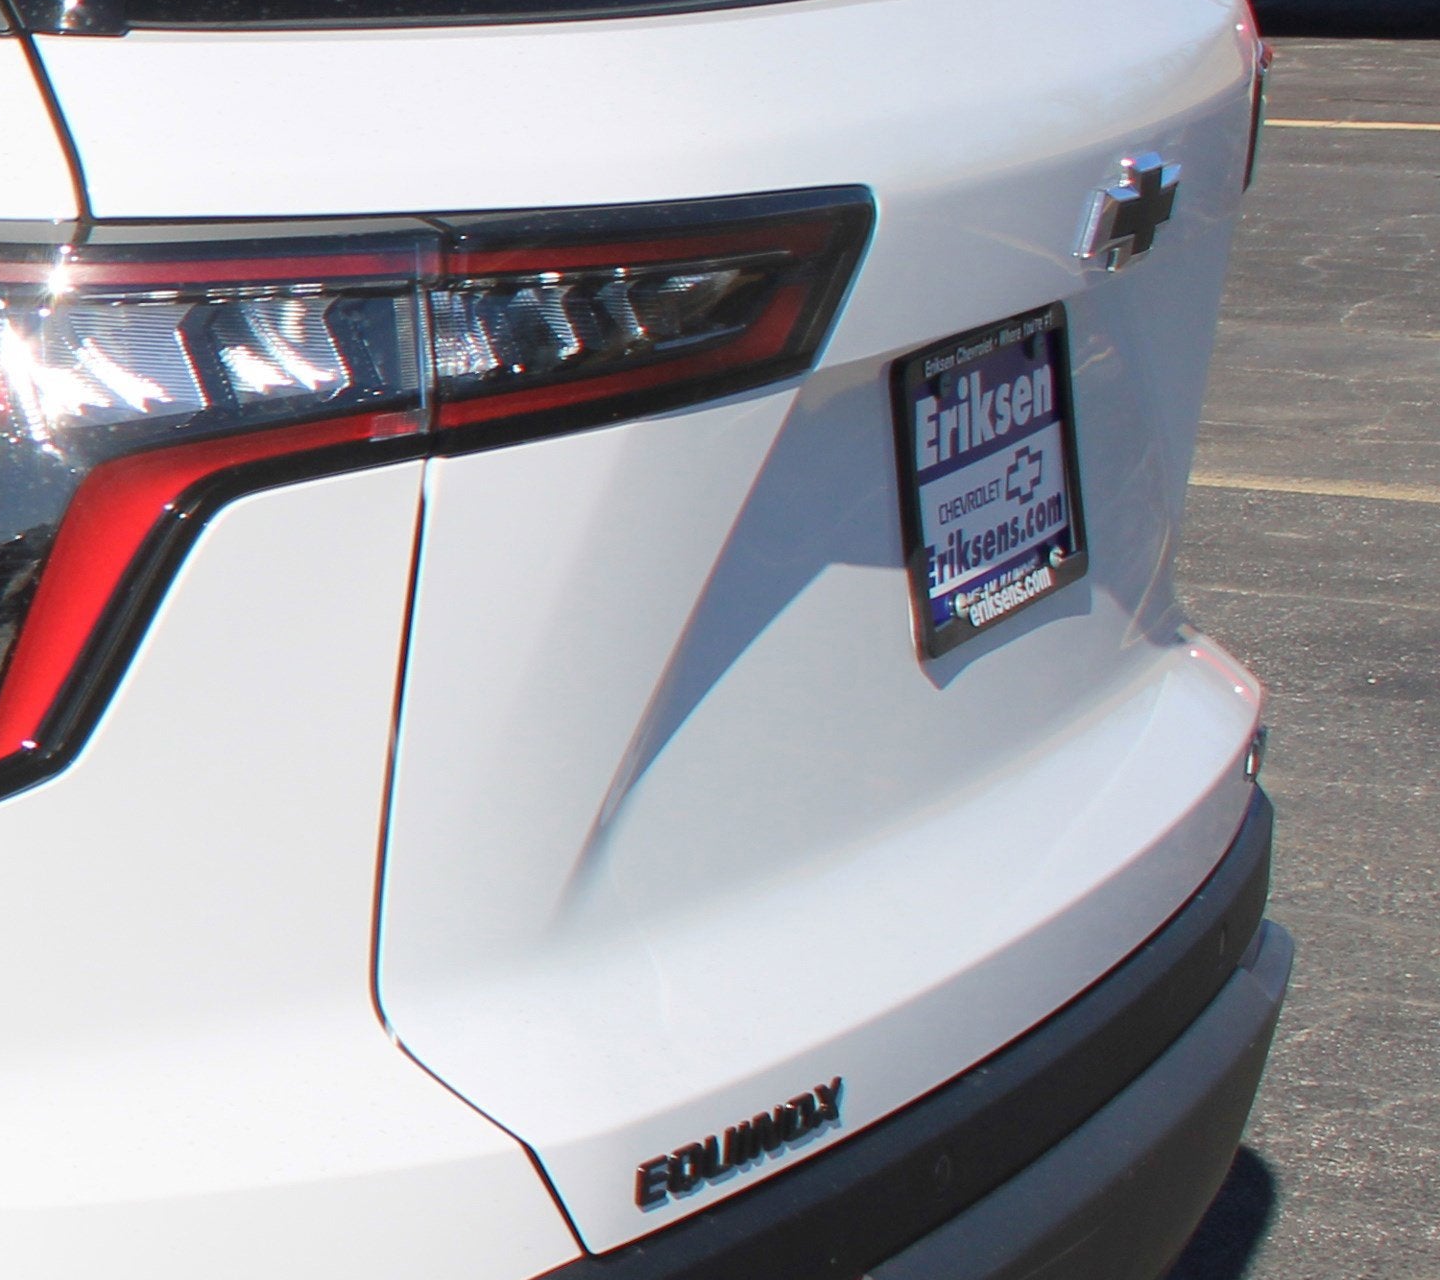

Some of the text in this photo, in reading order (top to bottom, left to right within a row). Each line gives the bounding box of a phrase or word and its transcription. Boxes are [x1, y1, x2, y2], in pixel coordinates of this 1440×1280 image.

[925, 354, 955, 378] Eriksen
[915, 364, 1053, 472] Eriksen
[925, 491, 1063, 588] Eriksens.com
[938, 478, 1001, 525] CHEVROLET
[969, 566, 1052, 627] eriksens.com
[635, 1076, 842, 1208] EQUINOX
